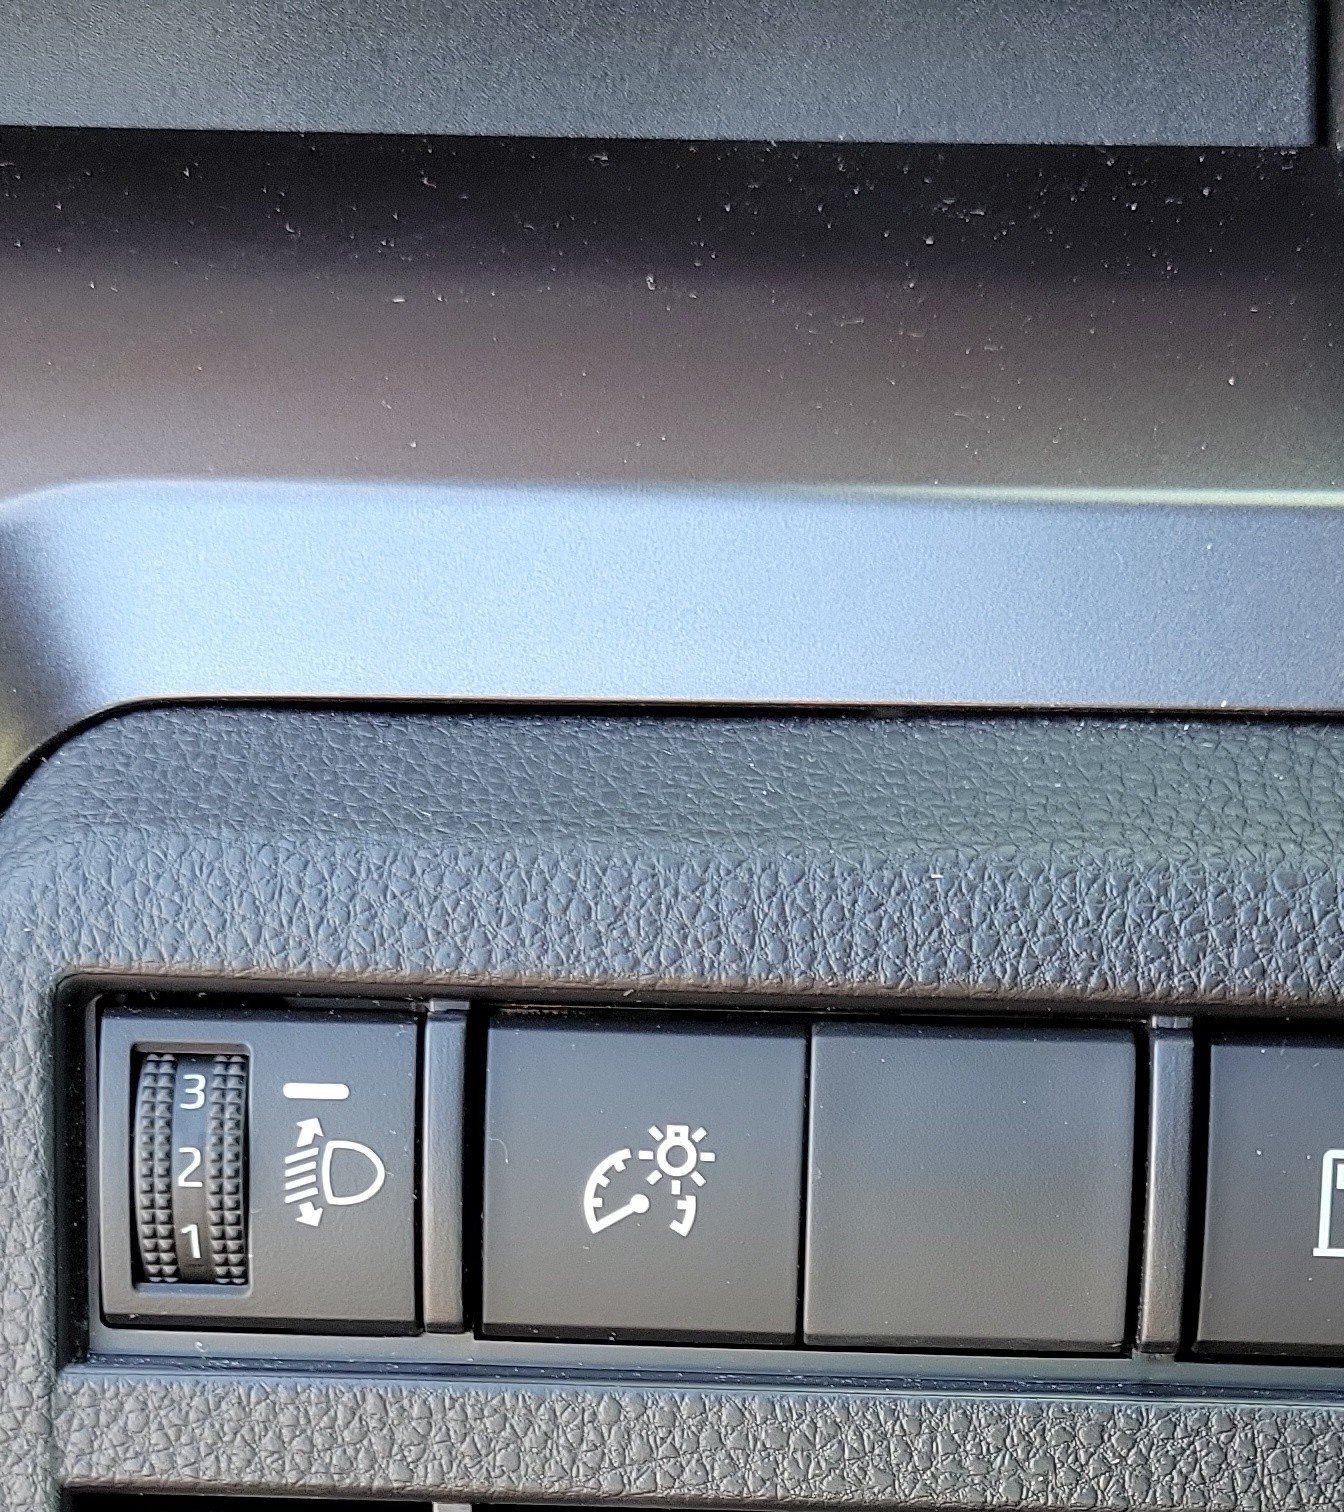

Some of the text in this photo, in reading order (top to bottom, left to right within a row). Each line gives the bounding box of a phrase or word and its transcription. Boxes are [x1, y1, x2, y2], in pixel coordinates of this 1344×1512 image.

[180, 1074, 206, 1110] 3
[177, 1147, 203, 1187] 2
[180, 1224, 201, 1258] 1
